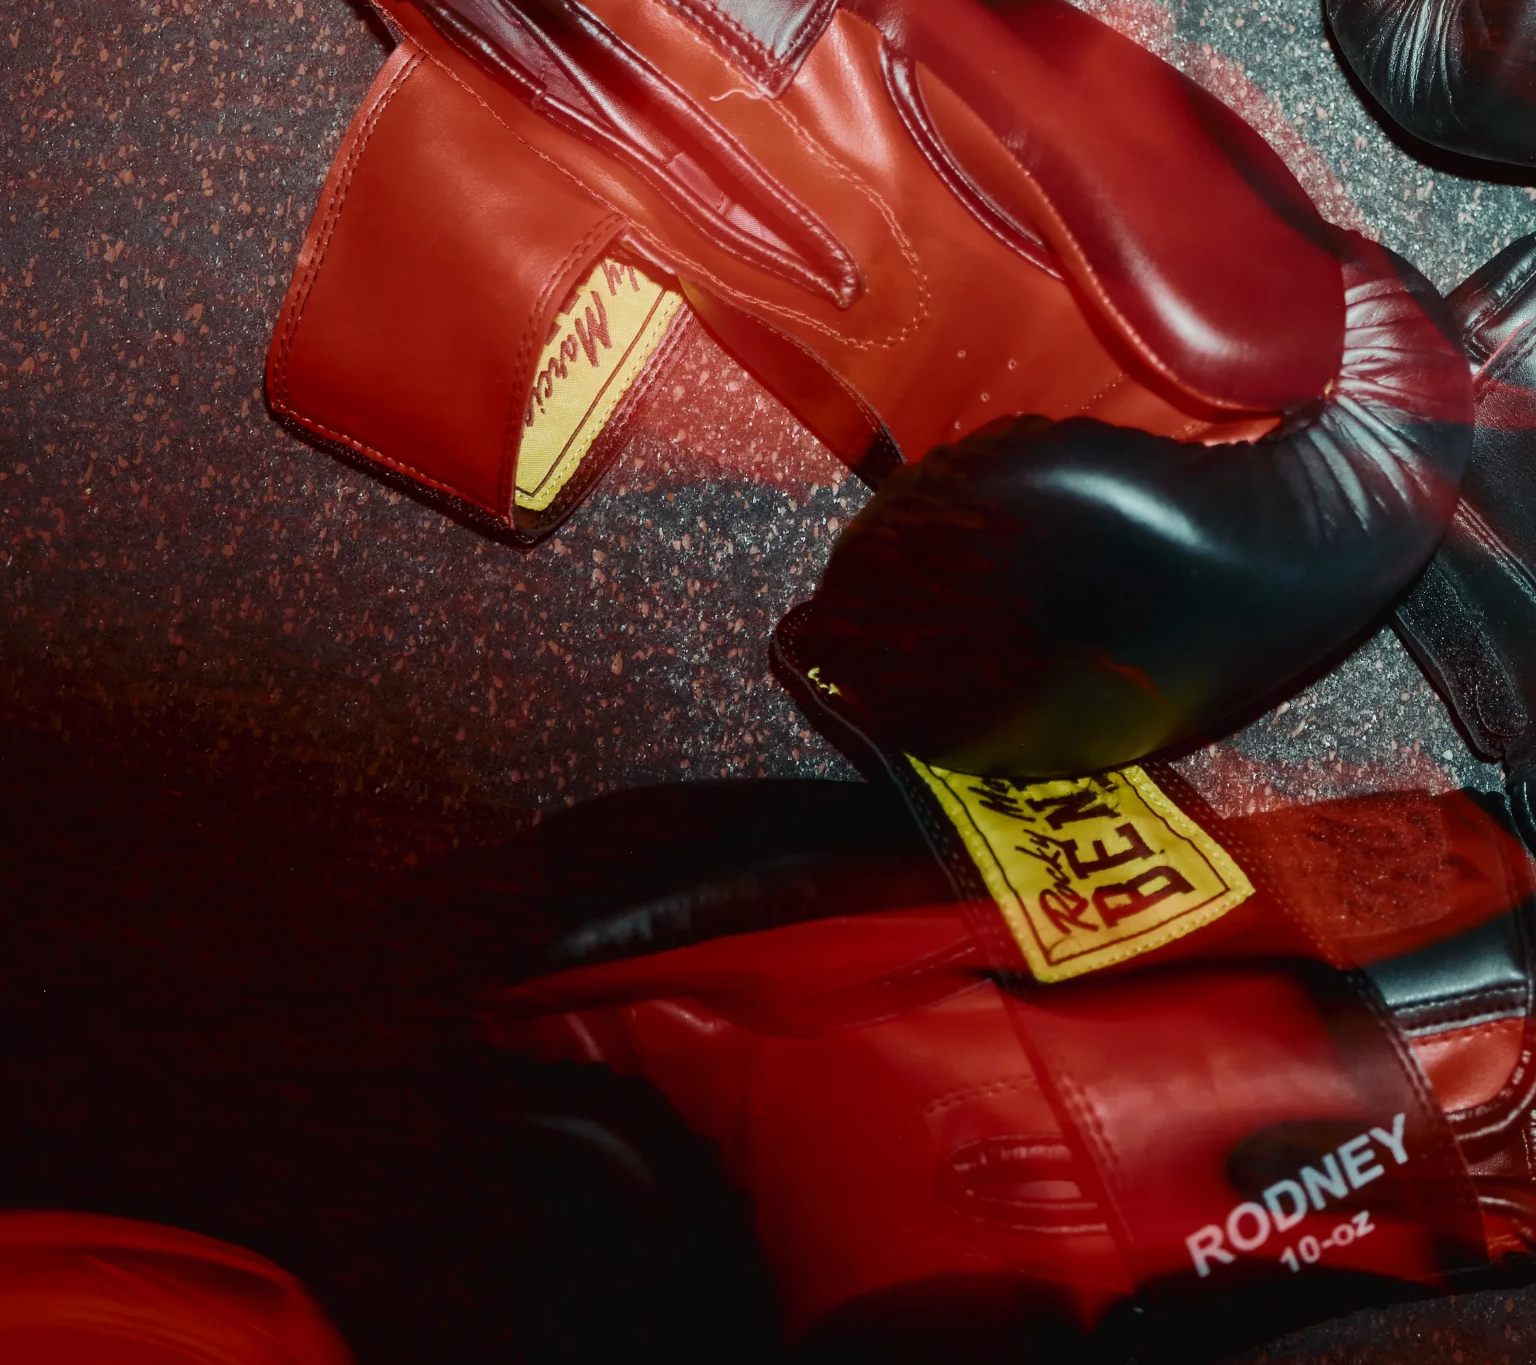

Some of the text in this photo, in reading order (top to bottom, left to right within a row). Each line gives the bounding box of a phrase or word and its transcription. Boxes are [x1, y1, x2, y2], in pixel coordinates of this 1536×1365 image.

[1015, 829, 1099, 935] Rocky
[1024, 781, 1196, 930] BEN
[1185, 1113, 1409, 1278] RODNEY
